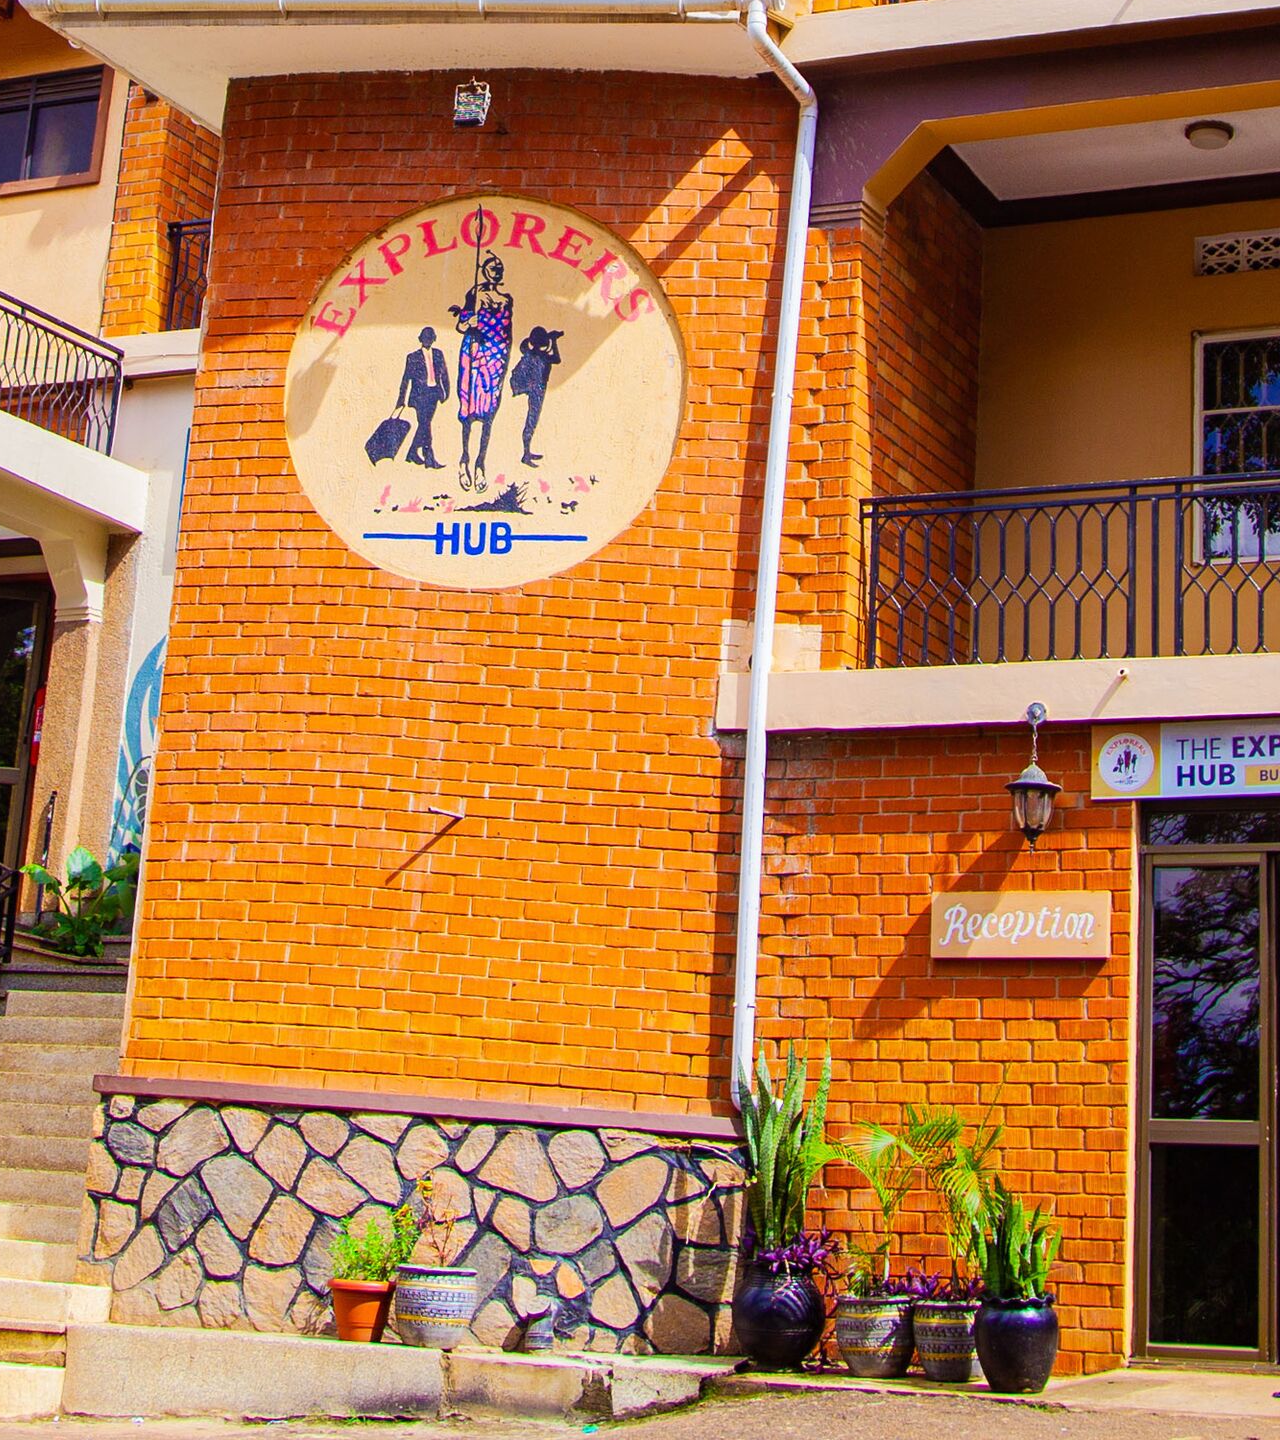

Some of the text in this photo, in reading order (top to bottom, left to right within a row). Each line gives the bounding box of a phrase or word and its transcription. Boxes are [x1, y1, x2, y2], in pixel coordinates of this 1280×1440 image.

[314, 209, 656, 338] EXPLORERS
[434, 521, 513, 556] HUB
[1176, 736, 1222, 760] THE
[1176, 763, 1236, 787] HUB
[939, 903, 1096, 946] Reception
